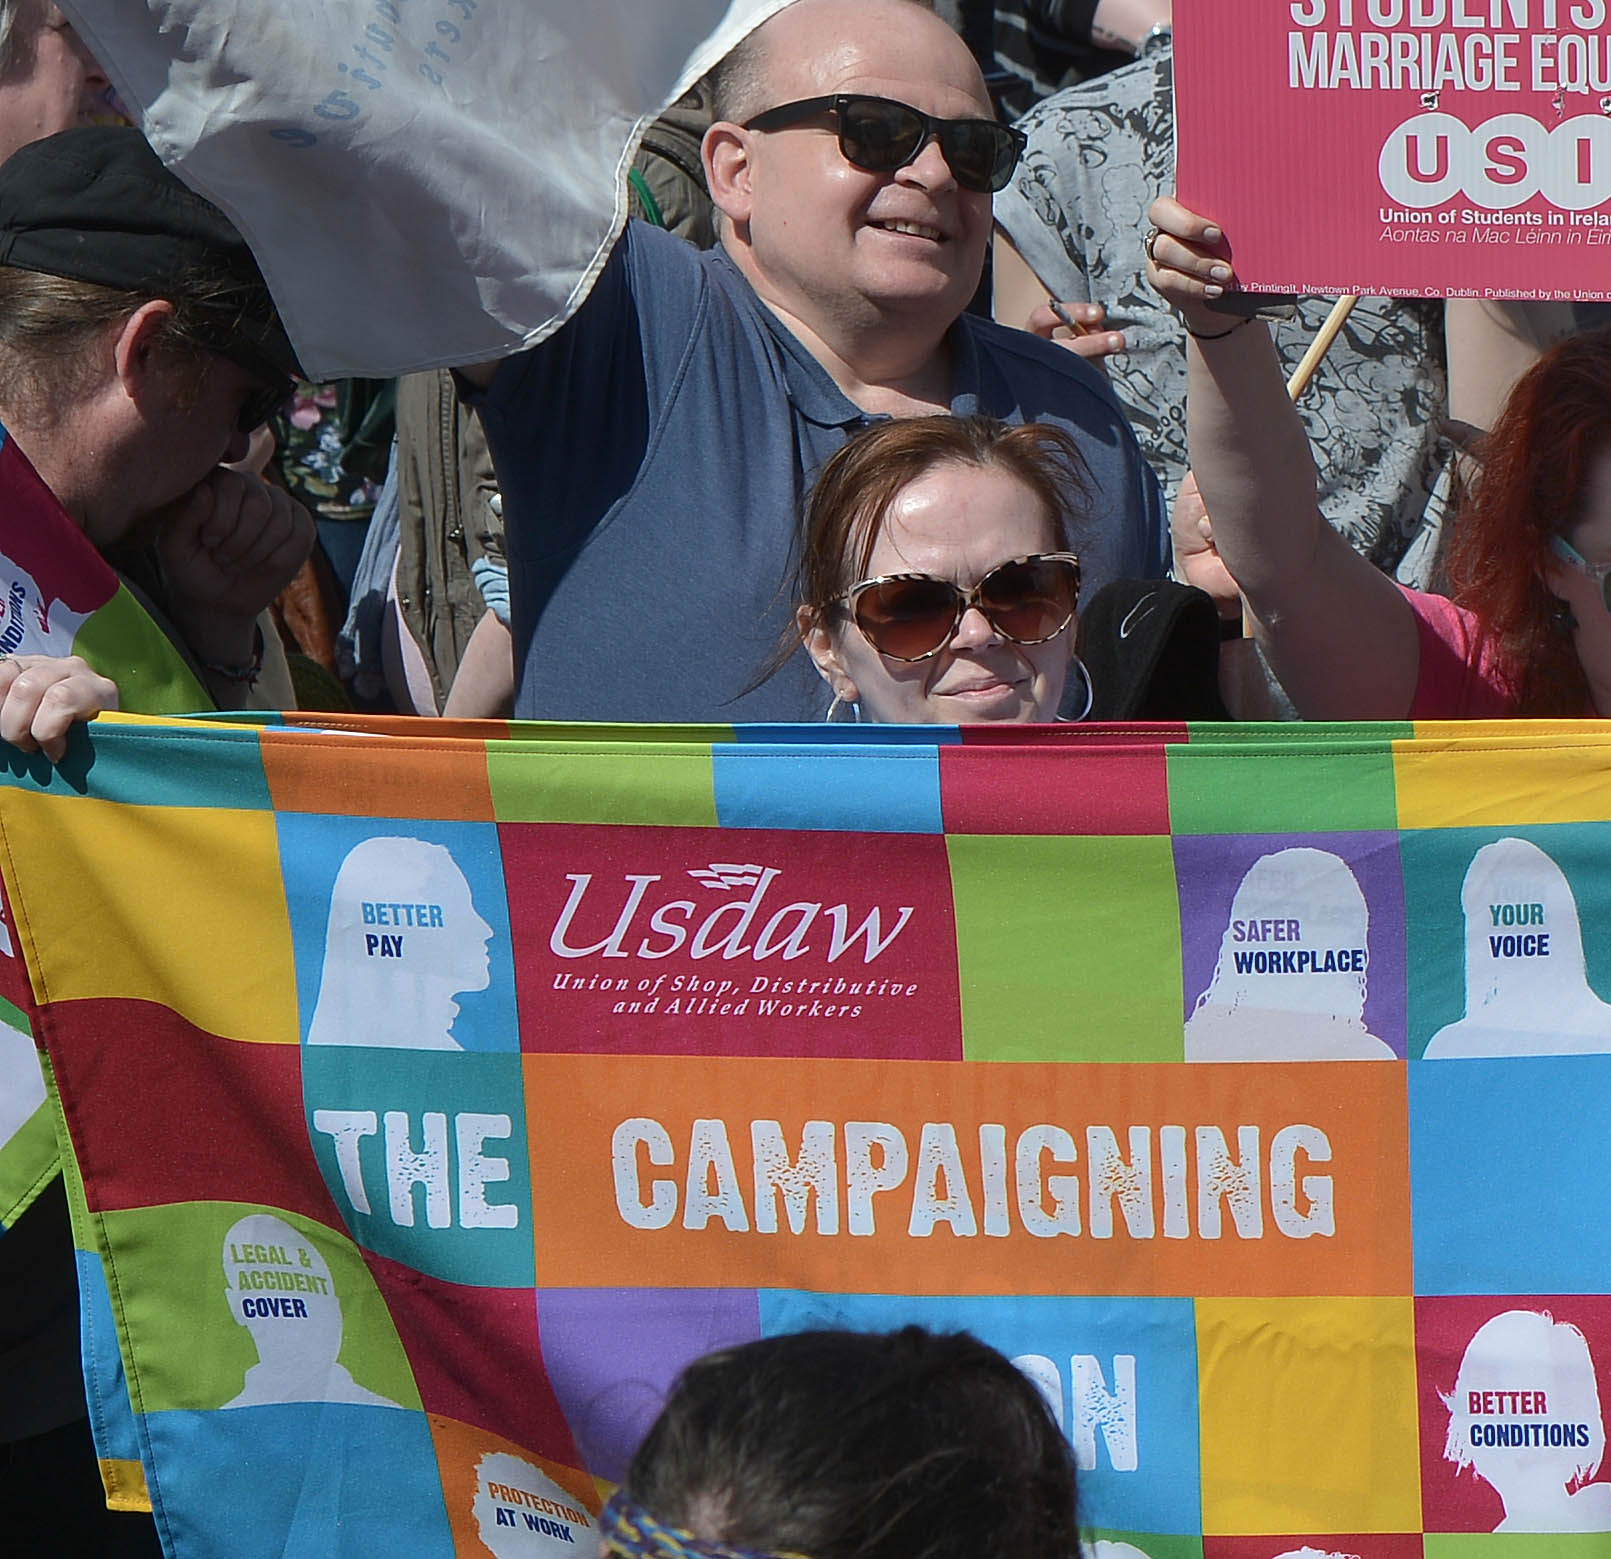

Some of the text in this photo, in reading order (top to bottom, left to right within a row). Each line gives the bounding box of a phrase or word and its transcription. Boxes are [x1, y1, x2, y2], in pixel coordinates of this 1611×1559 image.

[1288, 31, 1520, 90] MARRIAGE
[1405, 134, 1592, 185] USI
[1379, 208, 1433, 224] Union
[1438, 209, 1457, 225] of
[1461, 210, 1543, 226] Students
[1548, 211, 1564, 226] in
[1379, 226, 1440, 243] Aontas
[1445, 230, 1466, 243] na
[1472, 227, 1510, 244] Mac
[1515, 227, 1562, 244] Léinn
[1566, 228, 1582, 244] in
[1352, 285, 1377, 296] Park
[1573, 289, 1604, 300] Union
[361, 901, 444, 928] BETTER
[548, 864, 916, 965] Usdaw
[1489, 902, 1545, 927] YOUR
[1231, 918, 1301, 942] SAFER
[365, 934, 405, 958] PAY
[1489, 933, 1550, 958] VOICE
[1233, 948, 1366, 975] WORKPLACE
[551, 971, 919, 999] Union of Shop, Distributive
[611, 997, 863, 1019] and Allied Workers
[313, 1109, 520, 1230] THE
[611, 1117, 1336, 1240] CAMPAIGNING
[228, 1242, 312, 1269] LEGAL &
[237, 1270, 329, 1297] ACCIDENT
[241, 1297, 309, 1319] COVER
[1467, 1389, 1549, 1416] BETTER
[1469, 1422, 1591, 1449] CONDITIONS
[487, 1481, 592, 1529] PROTECTION
[495, 1506, 577, 1545] AT WORK
